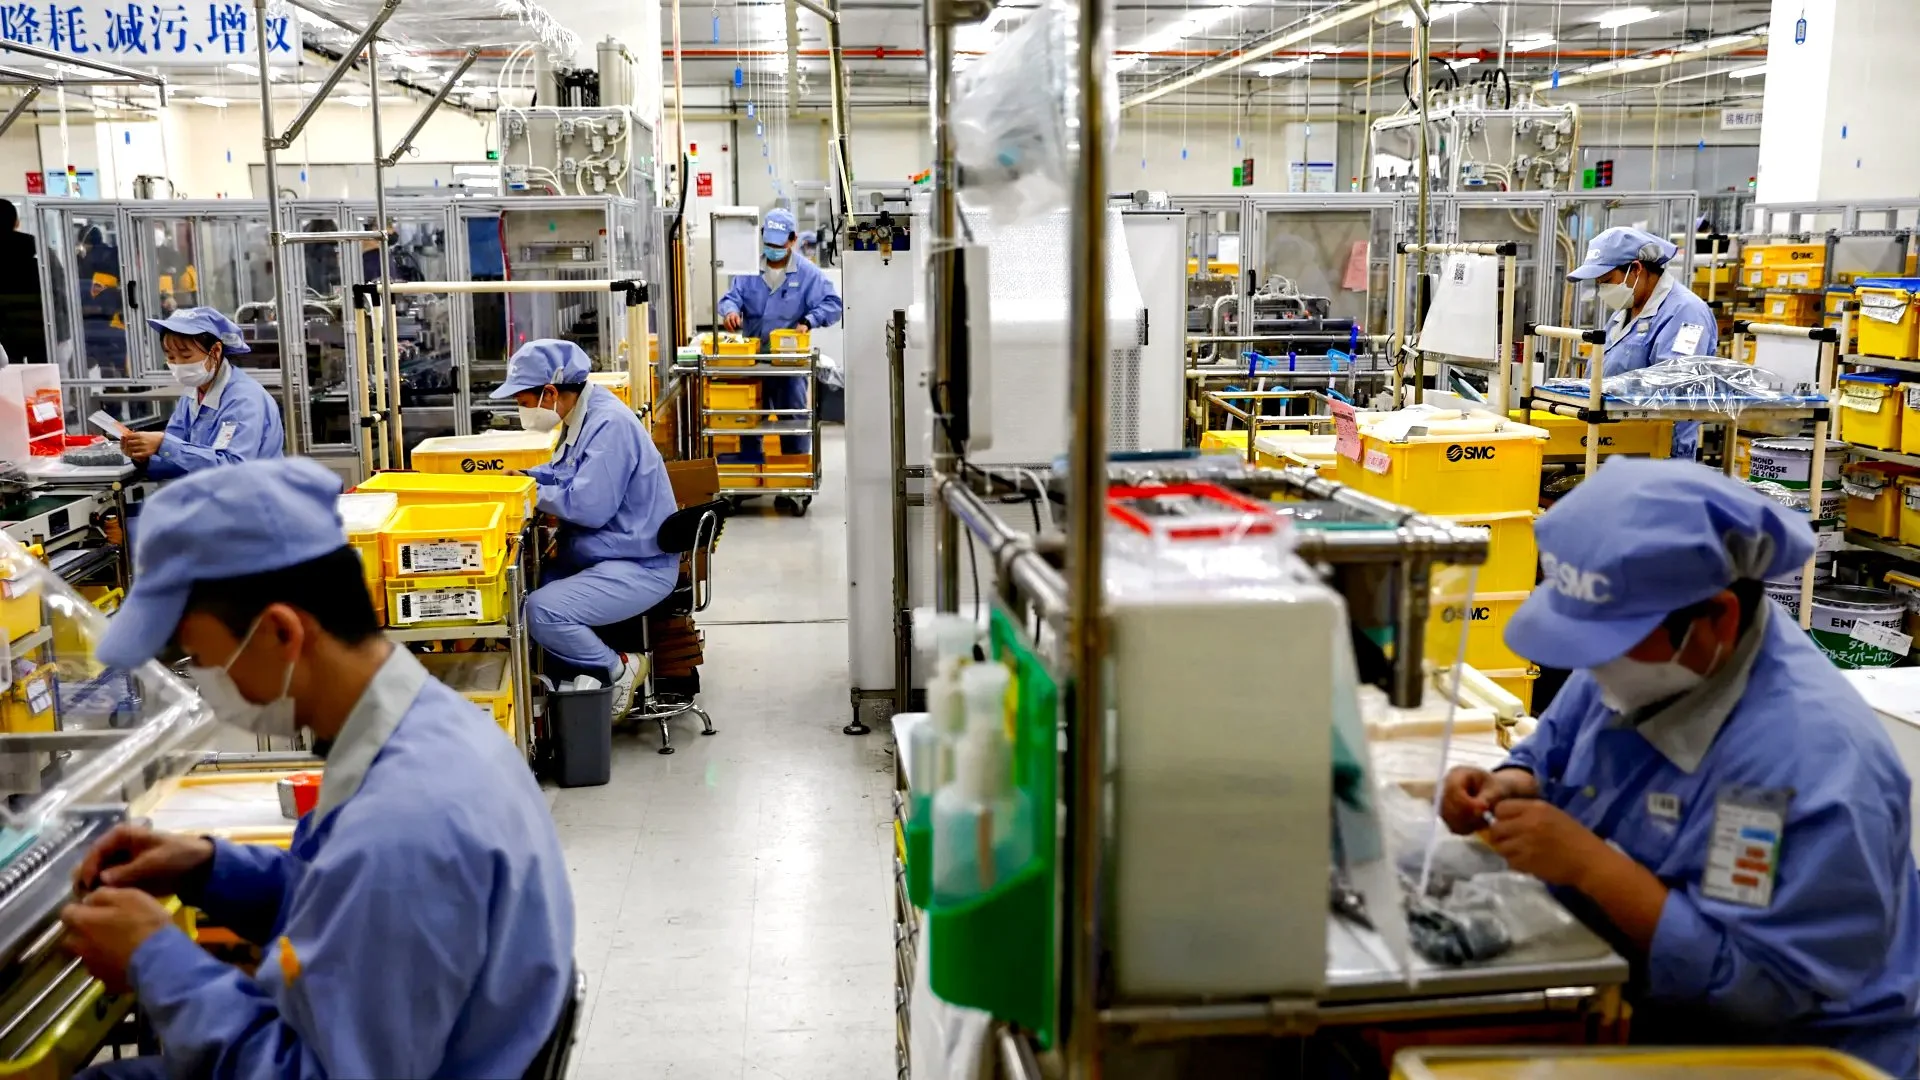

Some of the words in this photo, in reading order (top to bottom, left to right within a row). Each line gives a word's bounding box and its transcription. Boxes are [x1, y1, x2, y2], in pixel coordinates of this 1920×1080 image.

[1598, 437, 1613, 446] MC
[1463, 446, 1496, 460] SMC
[477, 459, 504, 470] SMC
[1752, 463, 1787, 473] PURPOSE
[1557, 561, 1613, 604] SMC
